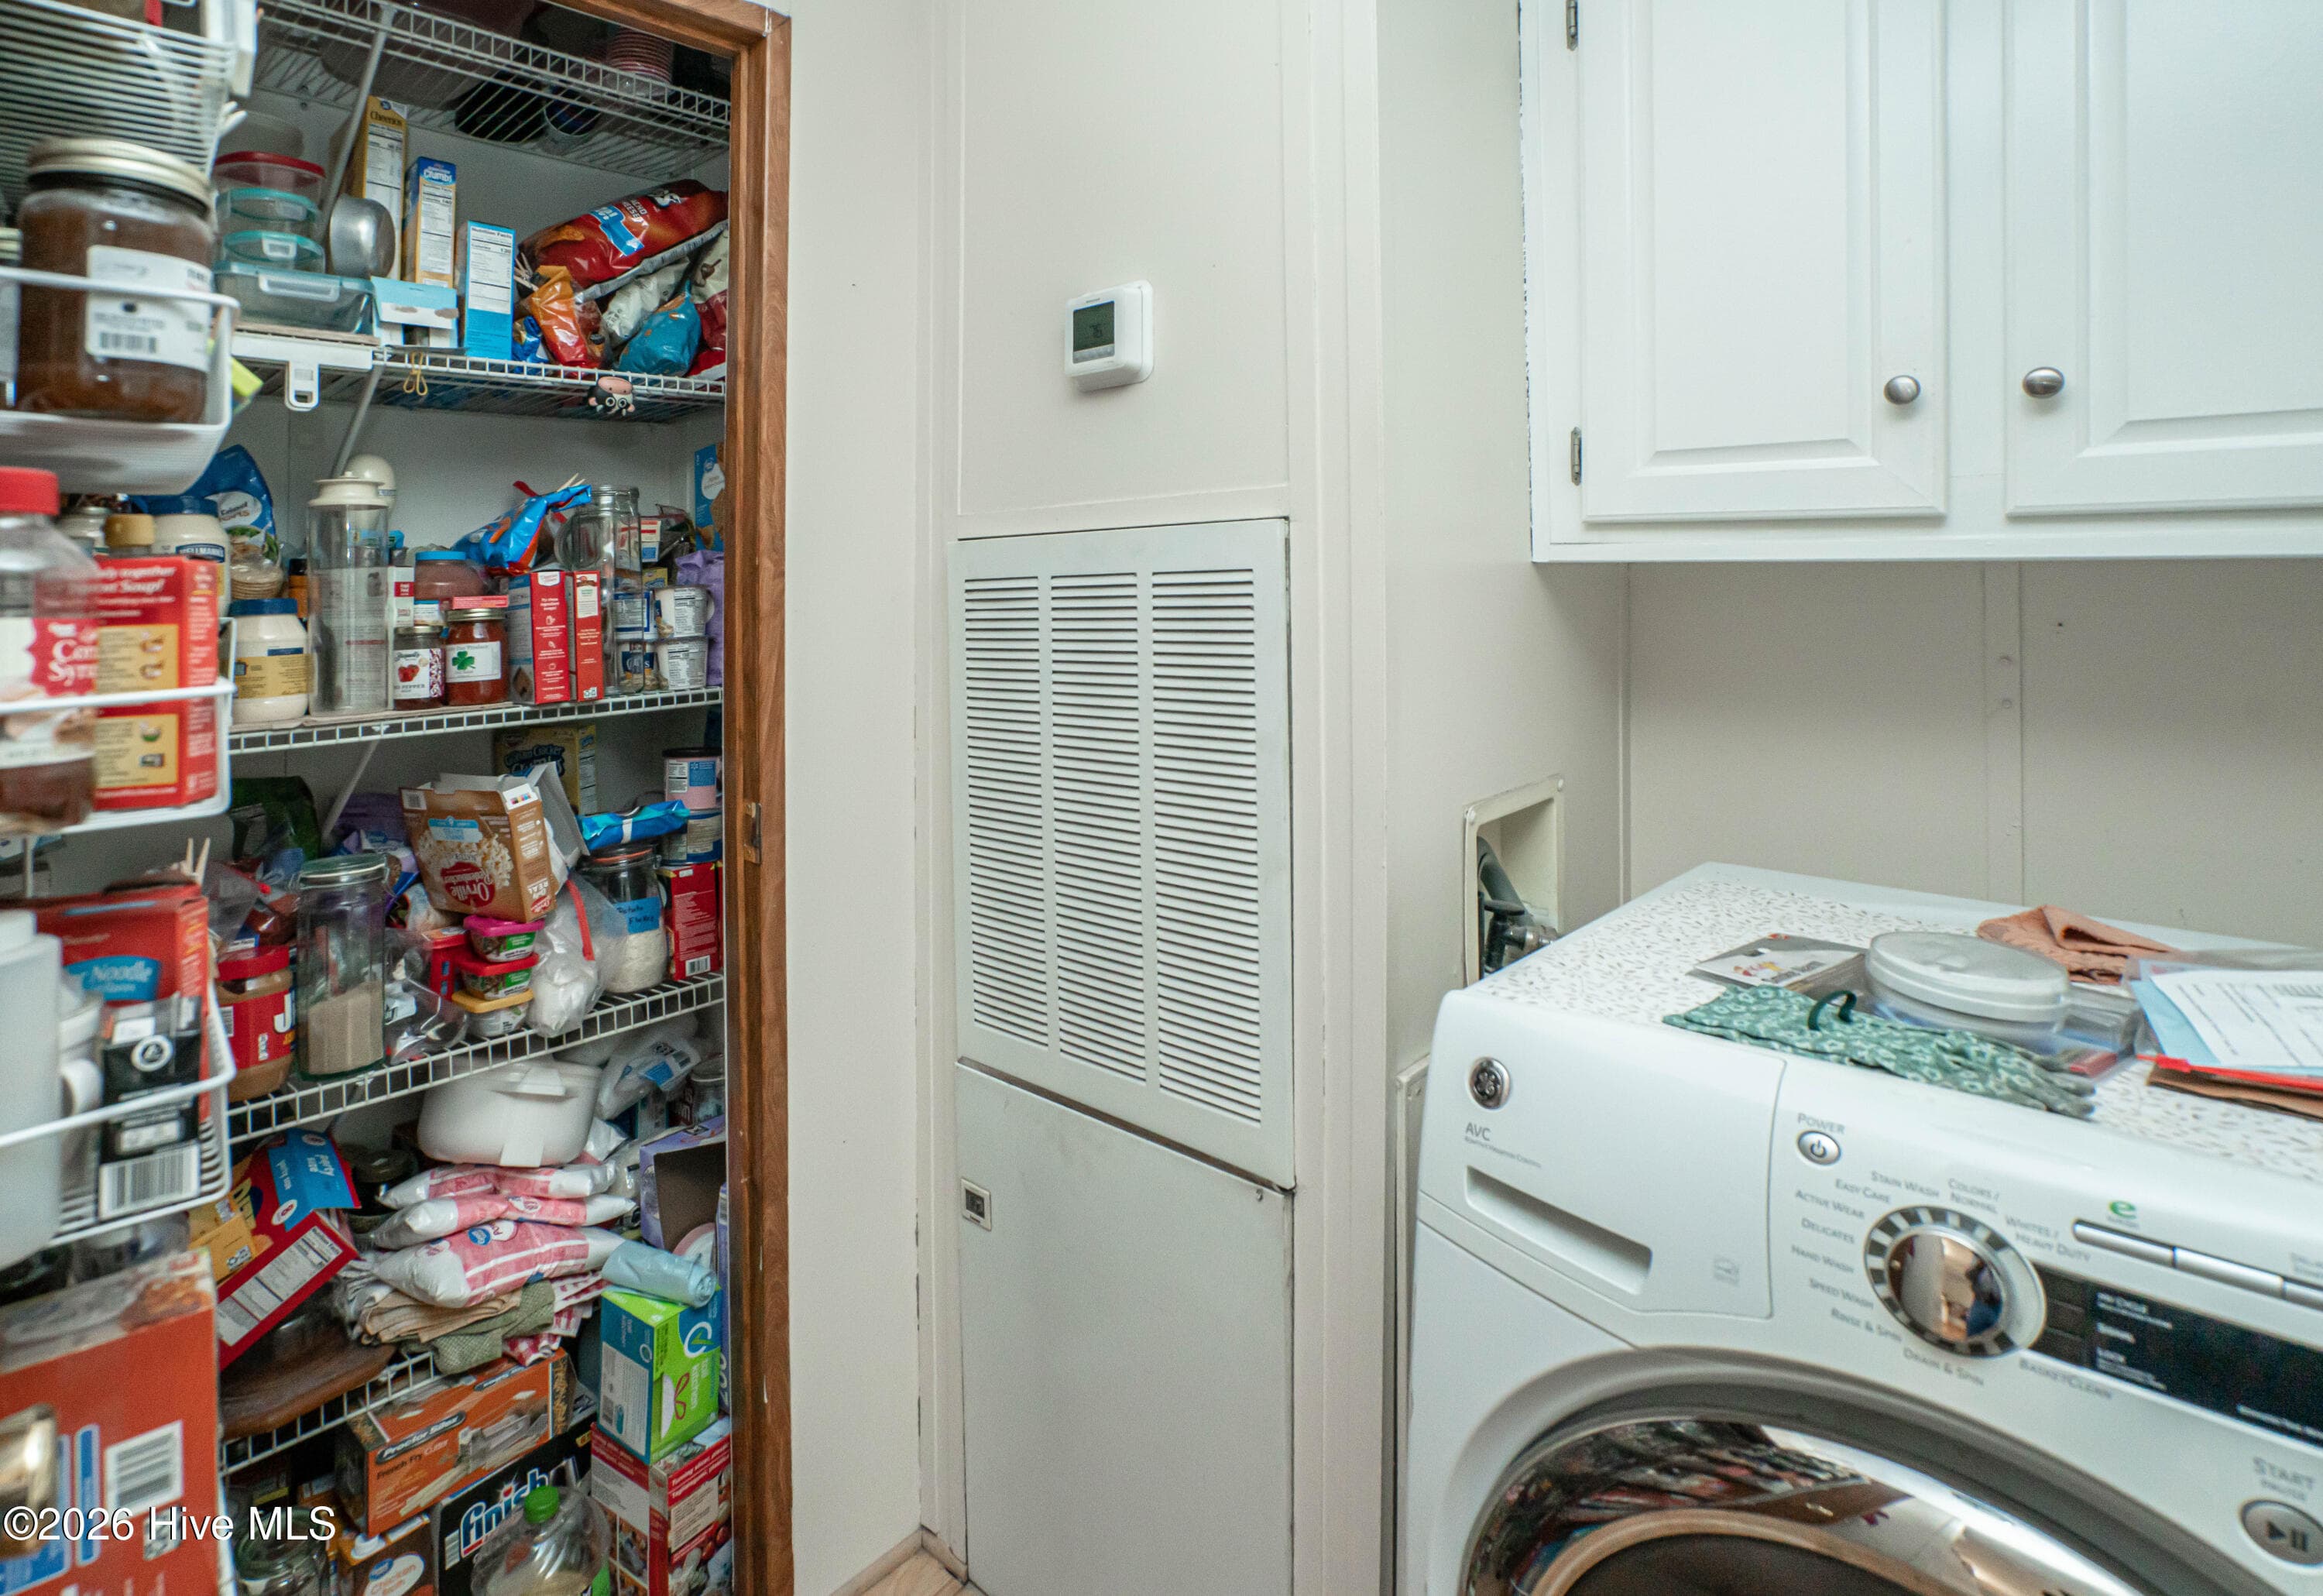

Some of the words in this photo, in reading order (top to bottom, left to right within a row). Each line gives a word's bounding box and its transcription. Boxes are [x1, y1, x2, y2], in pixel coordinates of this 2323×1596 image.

[450, 881, 490, 901] Orville
[1465, 1121, 1491, 1141] AVC
[1797, 1112, 1846, 1135] POWER
[1871, 1170, 1903, 1189] STAIN
[1947, 1176, 1992, 1200] COLORS
[1834, 1177, 1861, 1196] EASY
[1862, 1186, 1892, 1204] CARE
[1831, 1200, 1865, 1220] WEAR
[2253, 1456, 2315, 1491] START
